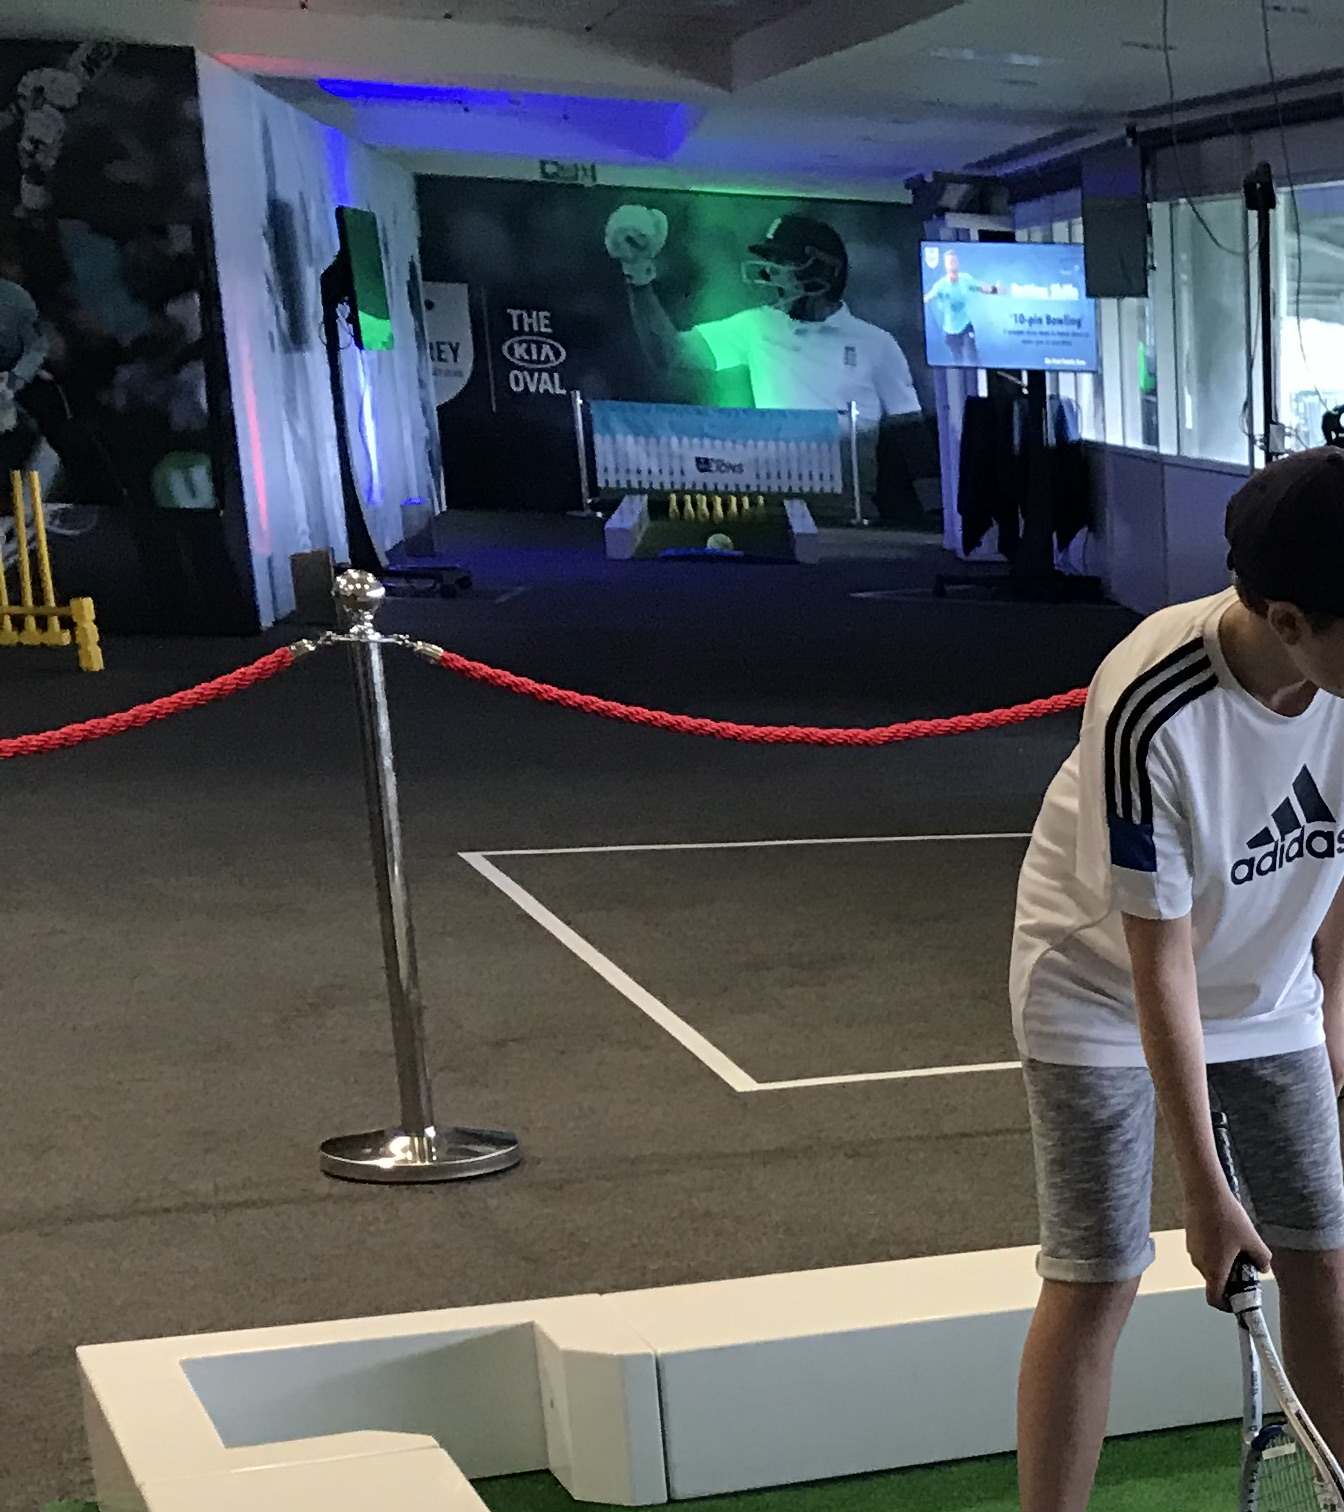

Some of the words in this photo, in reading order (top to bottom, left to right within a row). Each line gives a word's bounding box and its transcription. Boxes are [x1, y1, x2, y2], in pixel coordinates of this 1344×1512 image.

[506, 309, 553, 333] THE
[513, 342, 557, 362] KIA
[509, 369, 567, 395] OVAL
